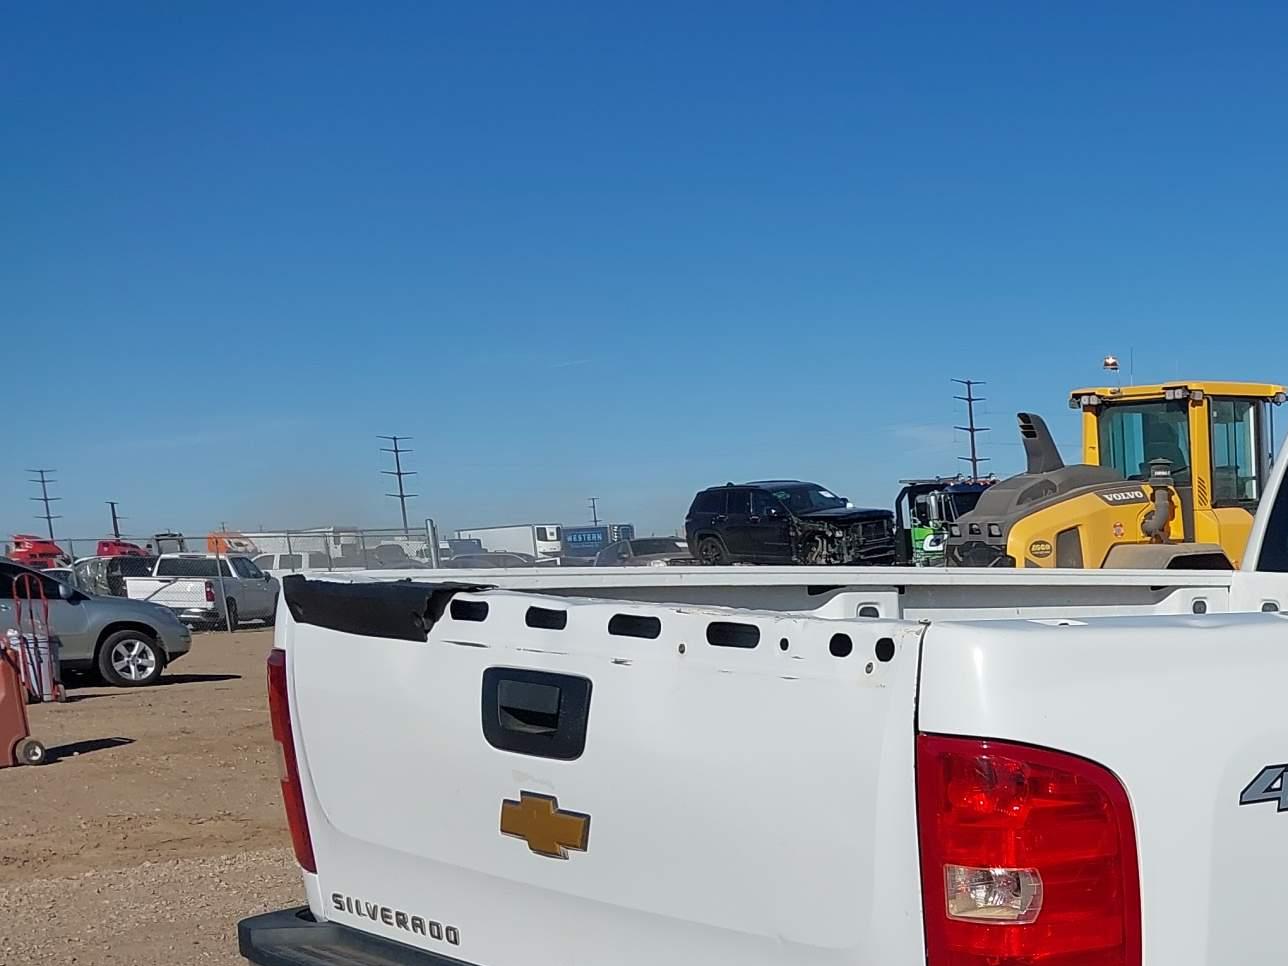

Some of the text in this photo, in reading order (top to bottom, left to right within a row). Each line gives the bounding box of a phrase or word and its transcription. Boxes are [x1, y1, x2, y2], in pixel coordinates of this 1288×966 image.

[1102, 491, 1143, 502] VOLVO
[567, 532, 602, 542] WESTERN
[332, 893, 460, 945] SILVERADO
